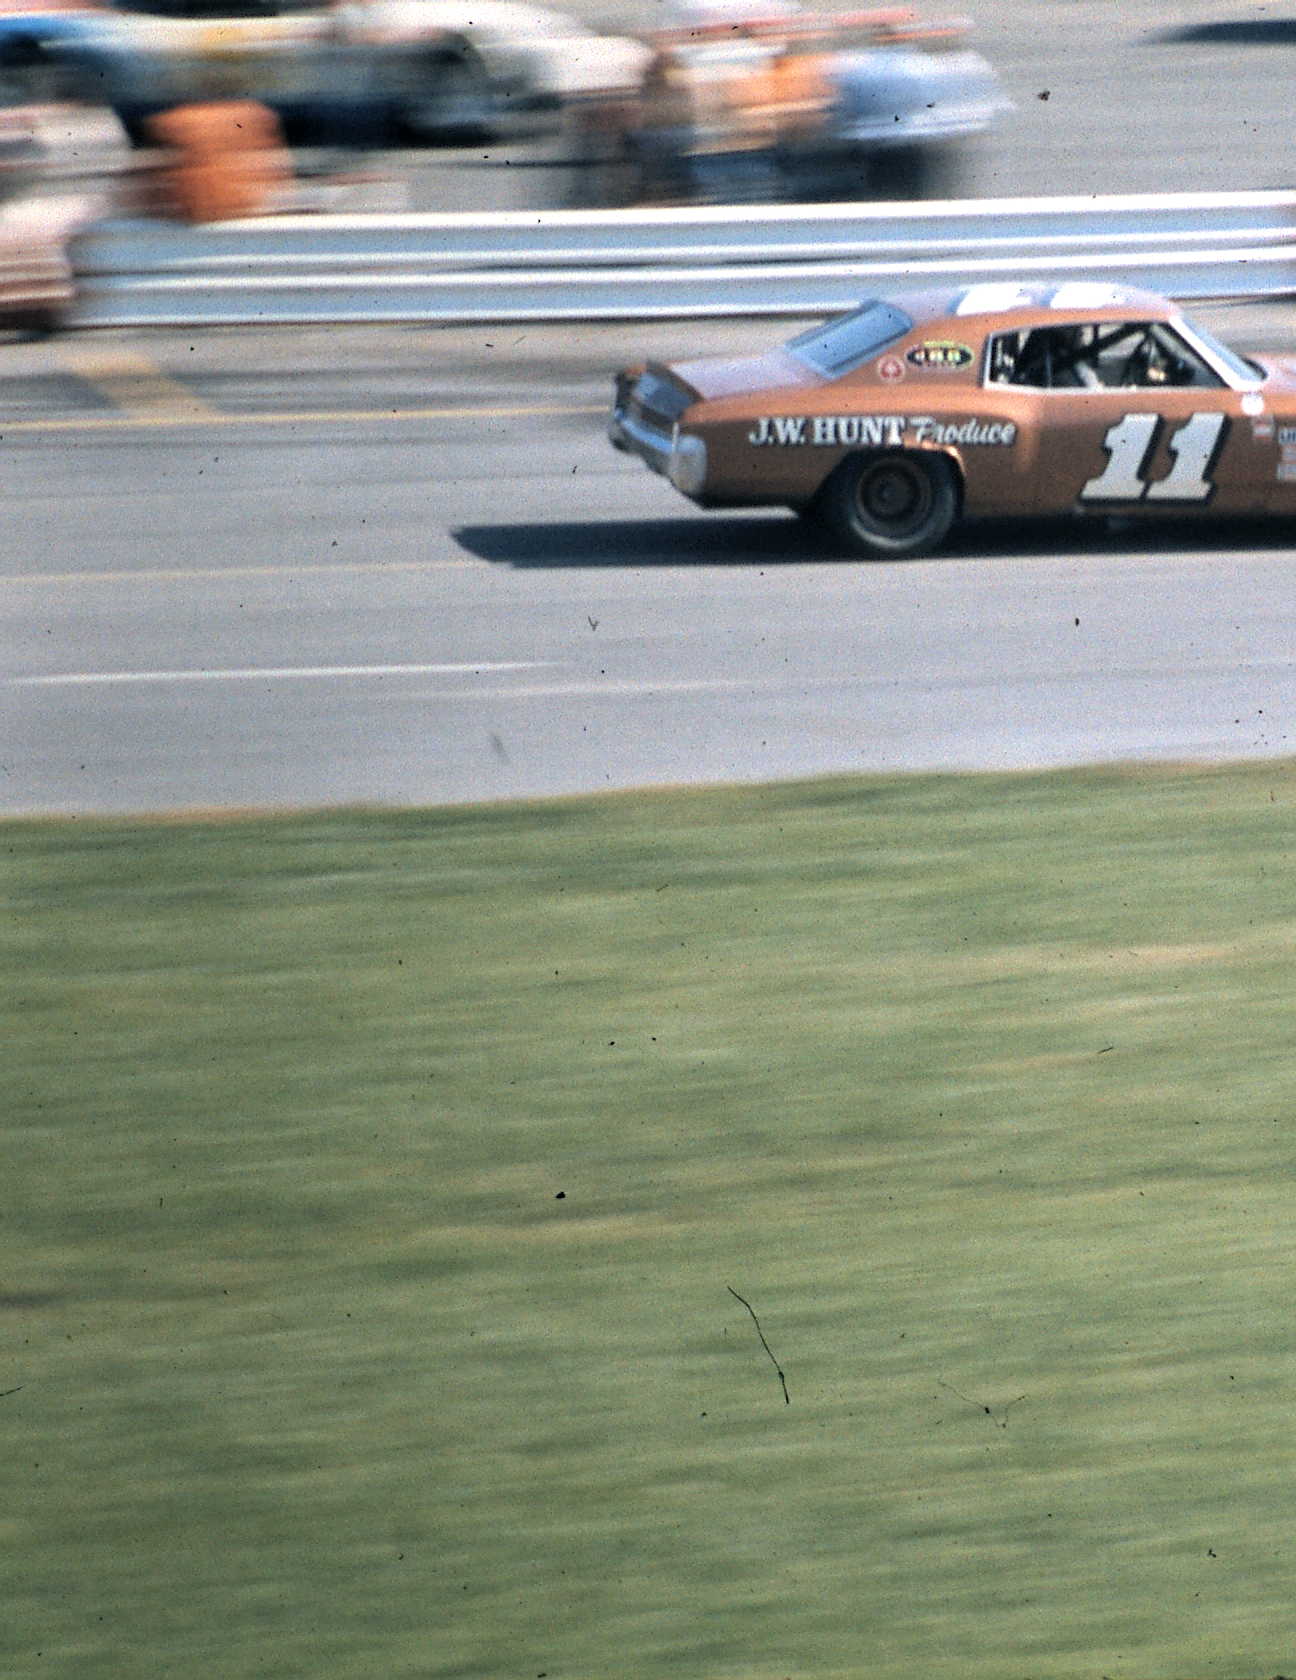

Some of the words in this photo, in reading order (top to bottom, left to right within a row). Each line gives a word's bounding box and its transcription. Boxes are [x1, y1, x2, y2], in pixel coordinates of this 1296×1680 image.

[814, 416, 905, 445] HUNT
[910, 416, 1017, 444] Produce
[1080, 412, 1230, 503] 11
